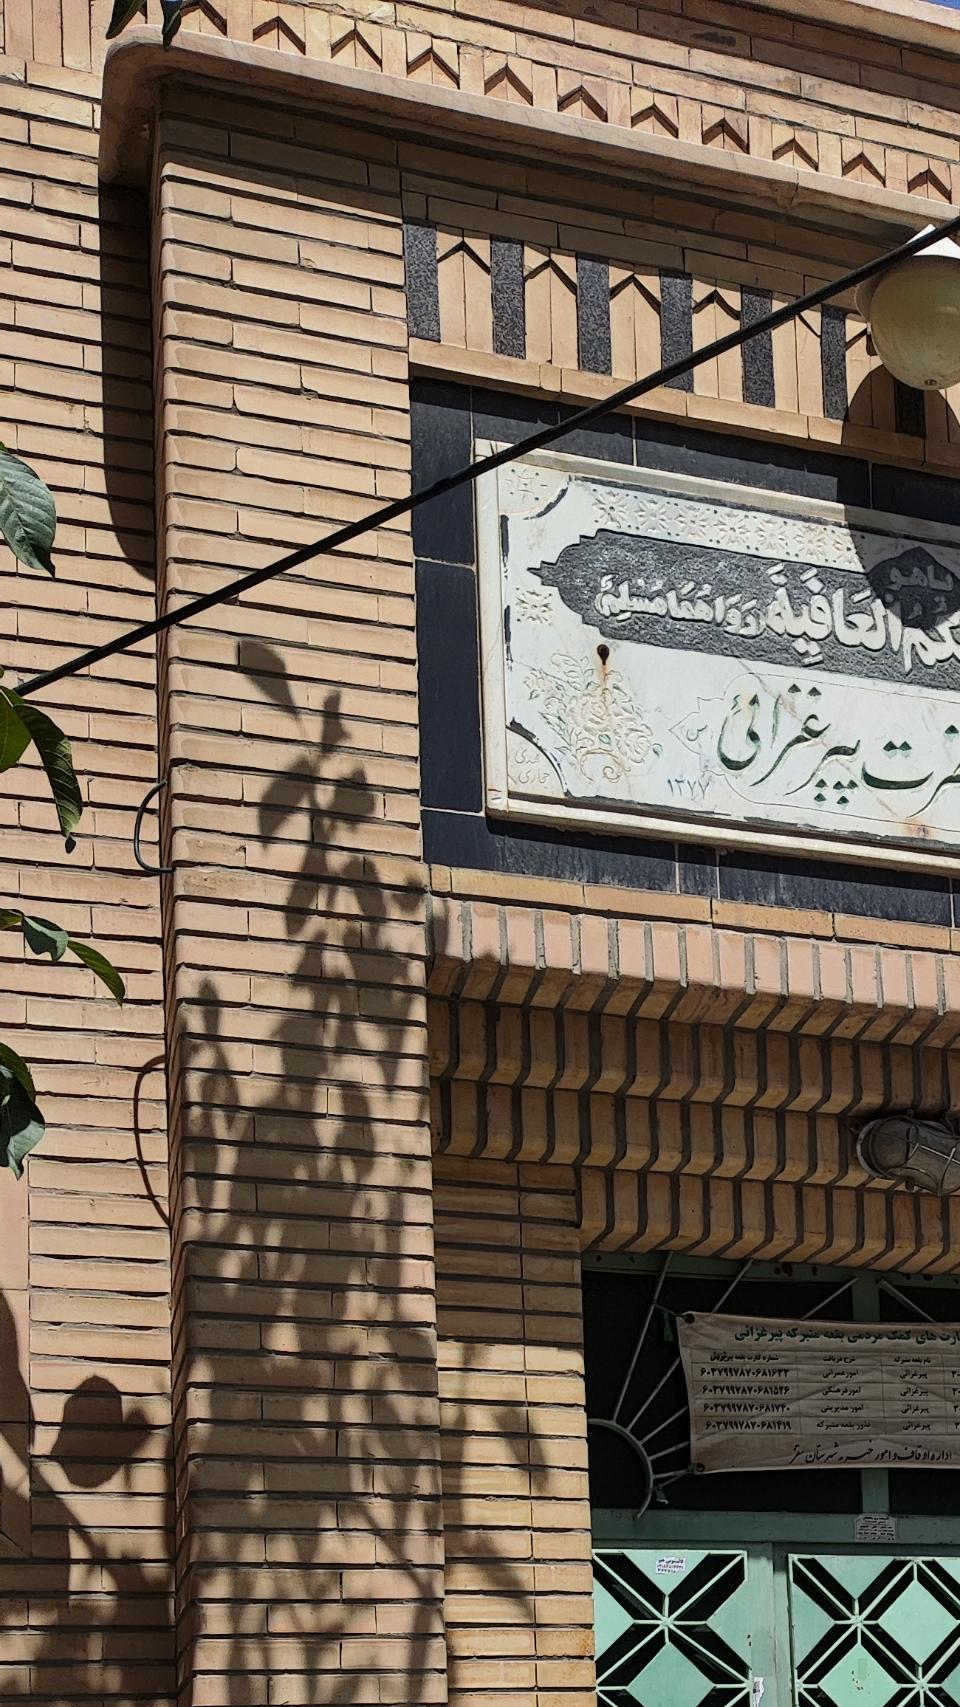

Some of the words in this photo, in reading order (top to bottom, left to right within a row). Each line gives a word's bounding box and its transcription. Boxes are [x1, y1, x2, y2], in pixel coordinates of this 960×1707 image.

[782, 739, 861, 805] پیر
[667, 776, 711, 800] ۱۳۷۷
[823, 1328, 845, 1343] بقعه
[847, 1328, 882, 1344] مردمی
[887, 1327, 912, 1341] کمک
[915, 1327, 937, 1344] های
[804, 1442, 839, 1463] شهرستان
[875, 1449, 891, 1461] امور
[896, 1445, 929, 1461] اوقاف
[929, 1450, 951, 1461] اداره
